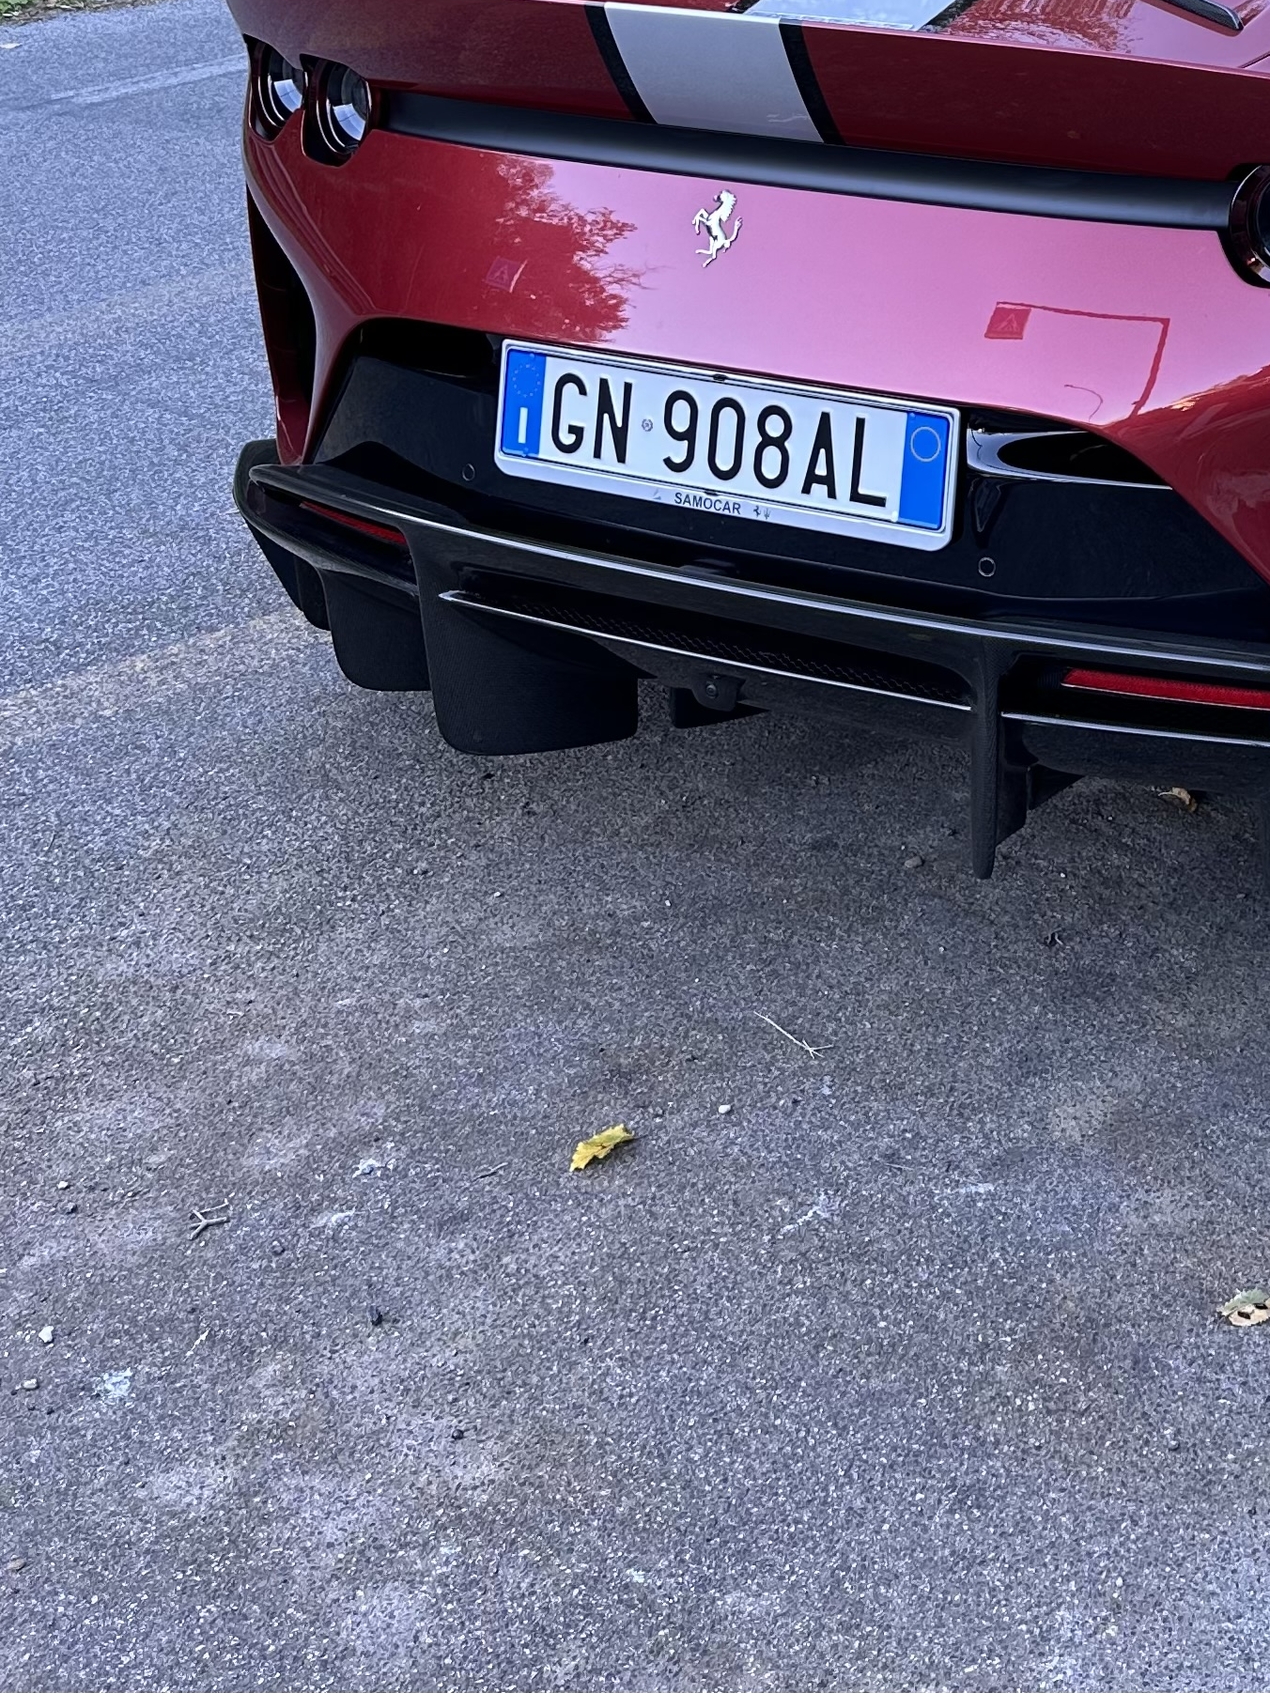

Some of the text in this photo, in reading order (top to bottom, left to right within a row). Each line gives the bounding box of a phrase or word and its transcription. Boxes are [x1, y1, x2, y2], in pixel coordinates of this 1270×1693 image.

[517, 372, 888, 508] I GN 908AL
[674, 492, 742, 515] SAMOCAR
